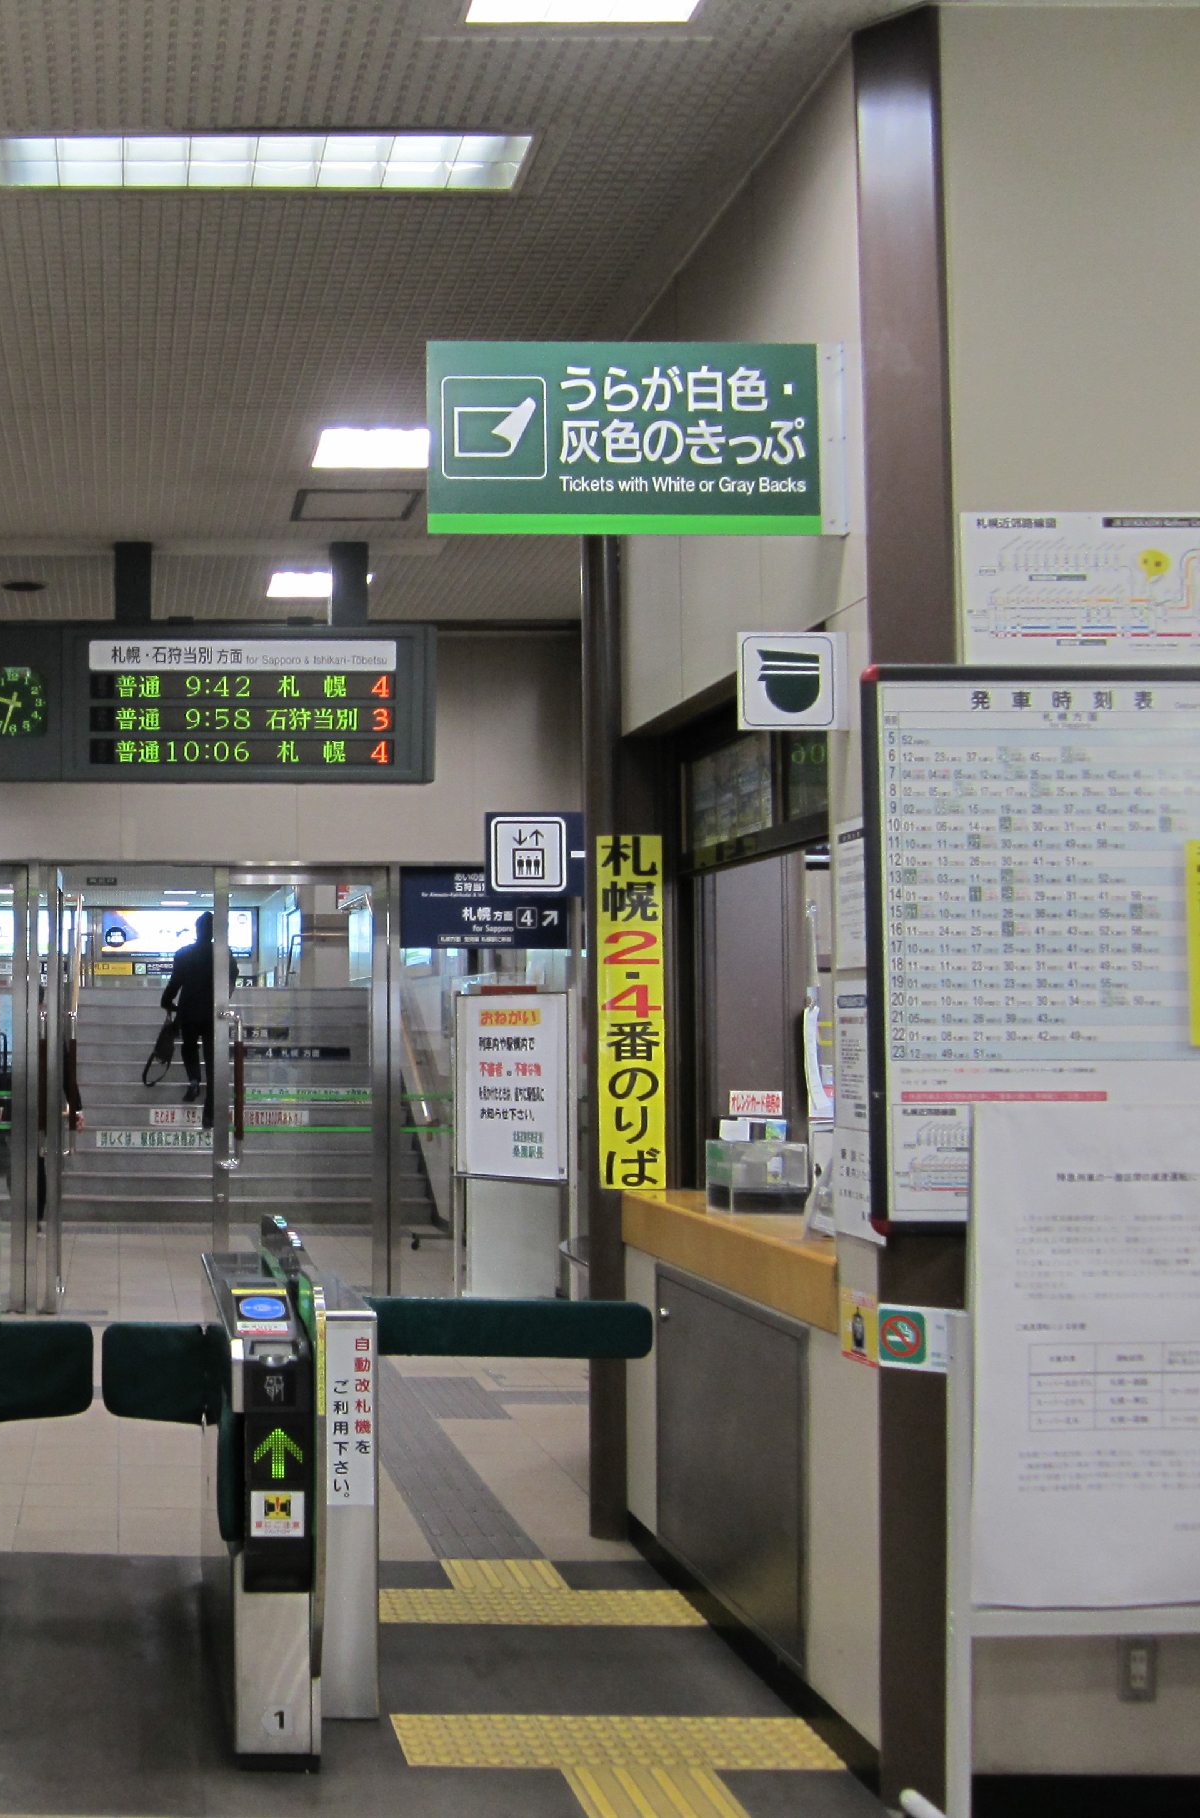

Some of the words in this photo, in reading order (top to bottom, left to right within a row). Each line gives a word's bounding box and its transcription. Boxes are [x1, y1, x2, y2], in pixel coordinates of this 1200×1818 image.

[560, 365, 794, 412] うらが白色・
[559, 418, 806, 466] 灰色のきっぷ
[559, 476, 614, 493] Tickets
[619, 476, 649, 493] with
[652, 476, 695, 493] White
[699, 480, 715, 493] or
[718, 476, 754, 496] Gray
[759, 477, 806, 494] Backs
[246, 655, 258, 665] for
[262, 655, 301, 667] Sapporo
[116, 675, 161, 698] 普通
[185, 675, 251, 698] 9:42
[371, 675, 389, 698] 4
[971, 690, 1153, 710] 発車時刻表
[116, 708, 161, 731] 普通
[185, 708, 251, 730] 9:58
[266, 708, 358, 731] 石狩当別
[372, 708, 390, 730] 3
[888, 731, 895, 744] 5
[116, 741, 161, 763] 普通
[166, 741, 251, 763] 10:06
[370, 741, 388, 763] 4
[888, 749, 895, 762] 6
[889, 766, 895, 779] 7
[889, 784, 896, 796] 8
[890, 801, 896, 814] 9
[888, 818, 900, 831] 10
[888, 836, 900, 848] 11
[889, 853, 901, 866] 12
[890, 870, 901, 883] 13
[890, 888, 902, 900] 14
[520, 909, 534, 927] 4
[890, 905, 902, 918] 15
[472, 924, 483, 932] for
[486, 924, 514, 933] Sapporo
[890, 922, 902, 935] 16
[891, 940, 902, 953] 17
[891, 957, 903, 971] 18
[892, 975, 904, 988] 19
[892, 992, 904, 1006] 20
[480, 1010, 537, 1026] おねがい
[892, 1010, 903, 1023] 21
[892, 1028, 905, 1041] 22
[893, 1046, 905, 1058] 23
[354, 1337, 371, 1455] 自動改札機を
[333, 1380, 350, 1498] ご利用下さい。
[273, 1711, 285, 1730] 1
